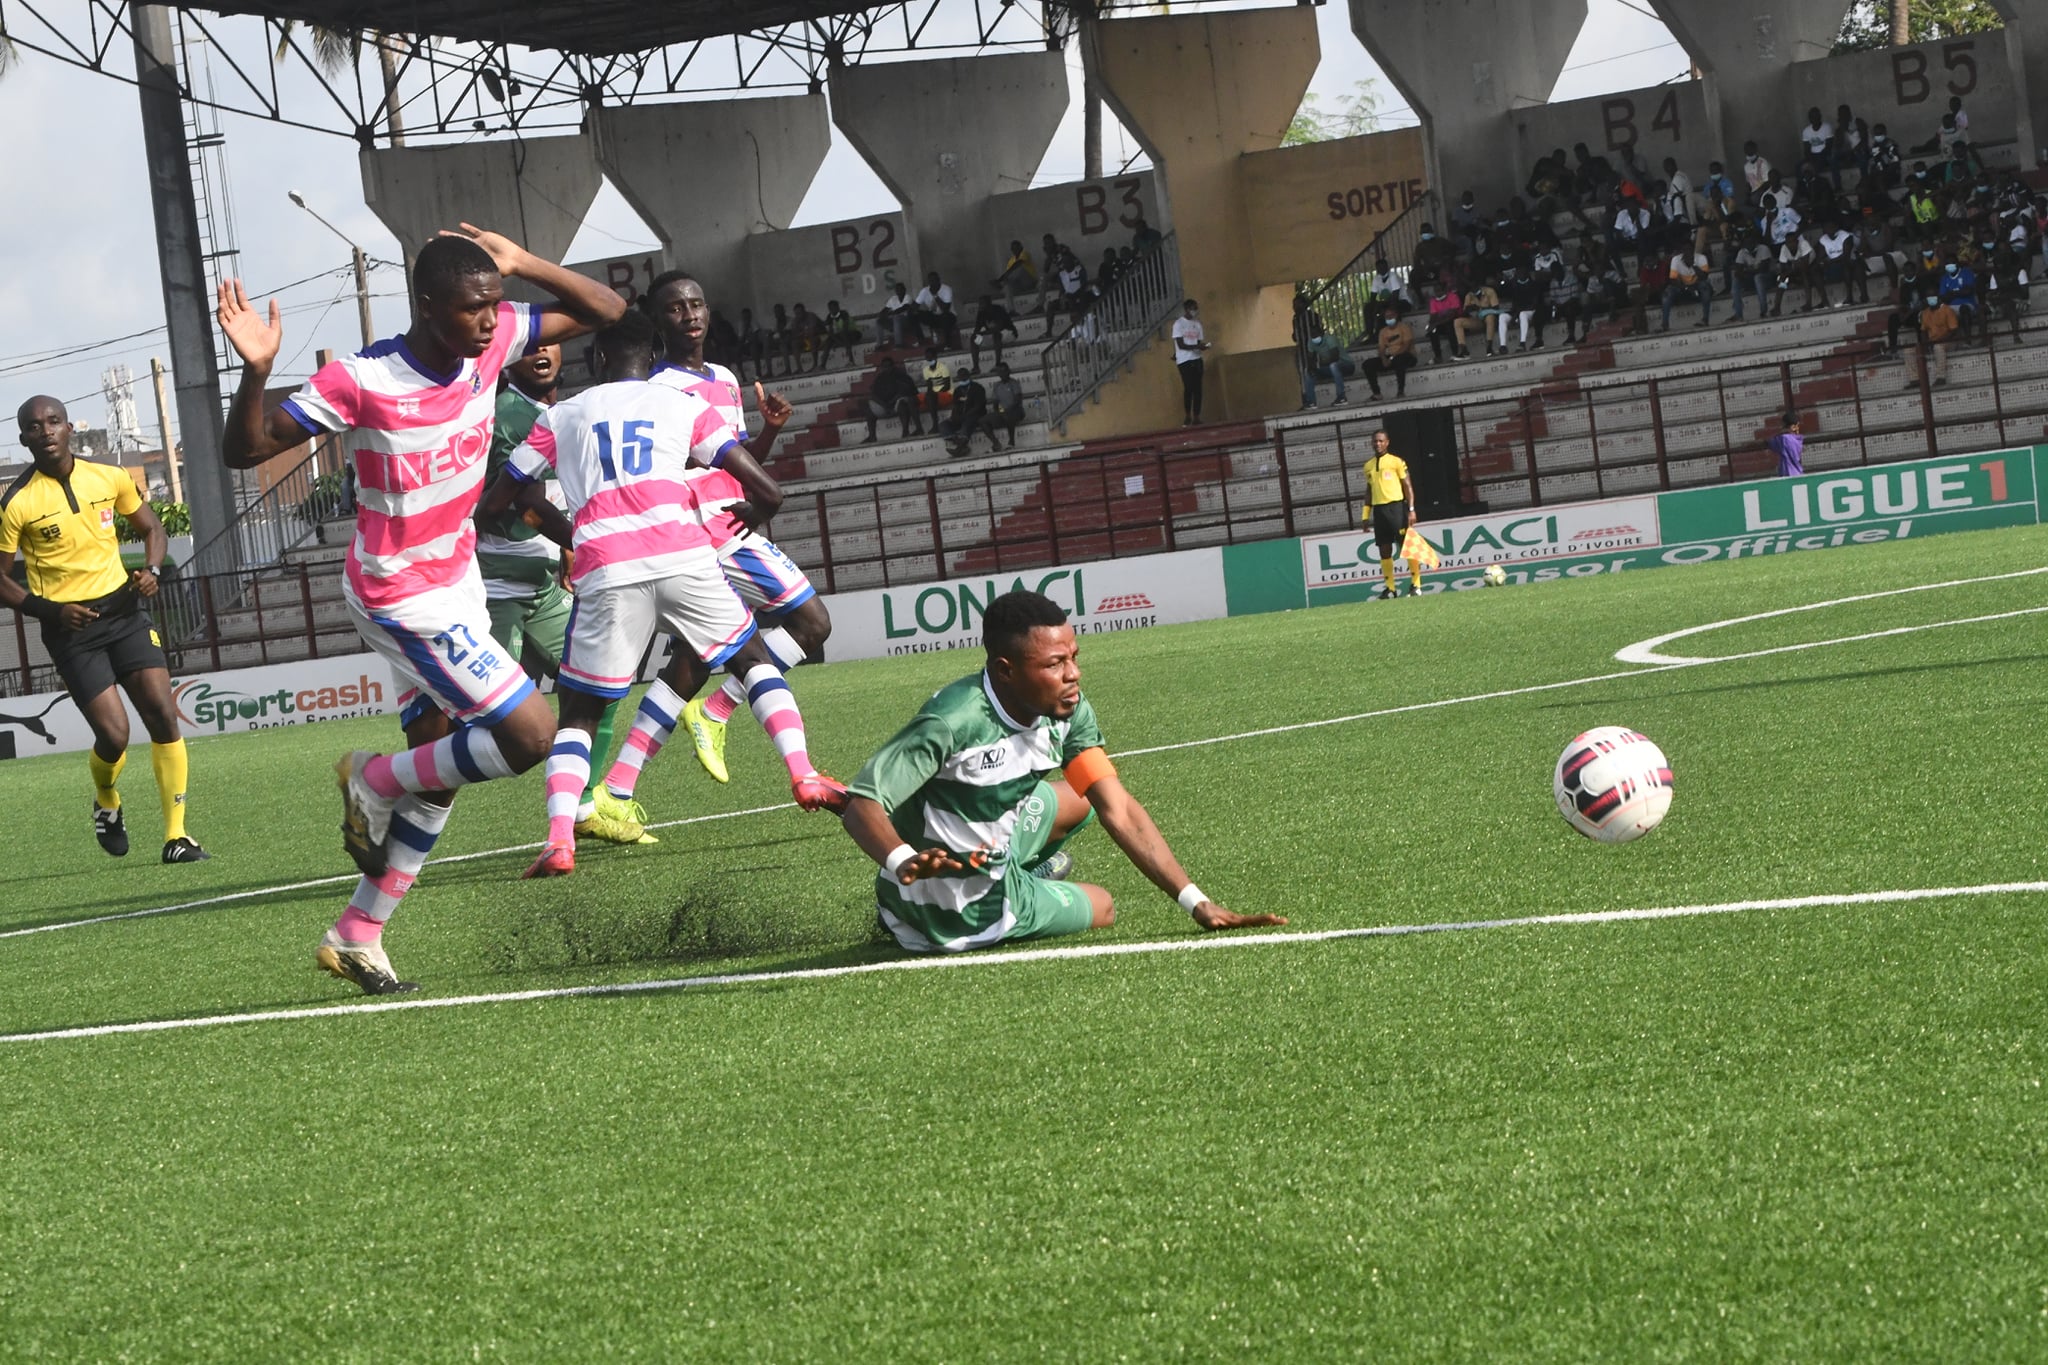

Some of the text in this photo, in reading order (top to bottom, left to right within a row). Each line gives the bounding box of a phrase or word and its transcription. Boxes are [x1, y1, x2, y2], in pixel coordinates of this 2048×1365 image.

[1327, 179, 1422, 220] SORTIE
[831, 219, 898, 274] B2
[592, 420, 654, 481] 15
[1395, 552, 1485, 573] NINALE
[1494, 552, 1512, 562] DE
[1568, 537, 1643, 552] D'IVOIRE
[1661, 520, 1912, 565] Officiel
[433, 624, 479, 666] 27
[194, 675, 383, 731] sportcash
[1023, 795, 1045, 833] 20
